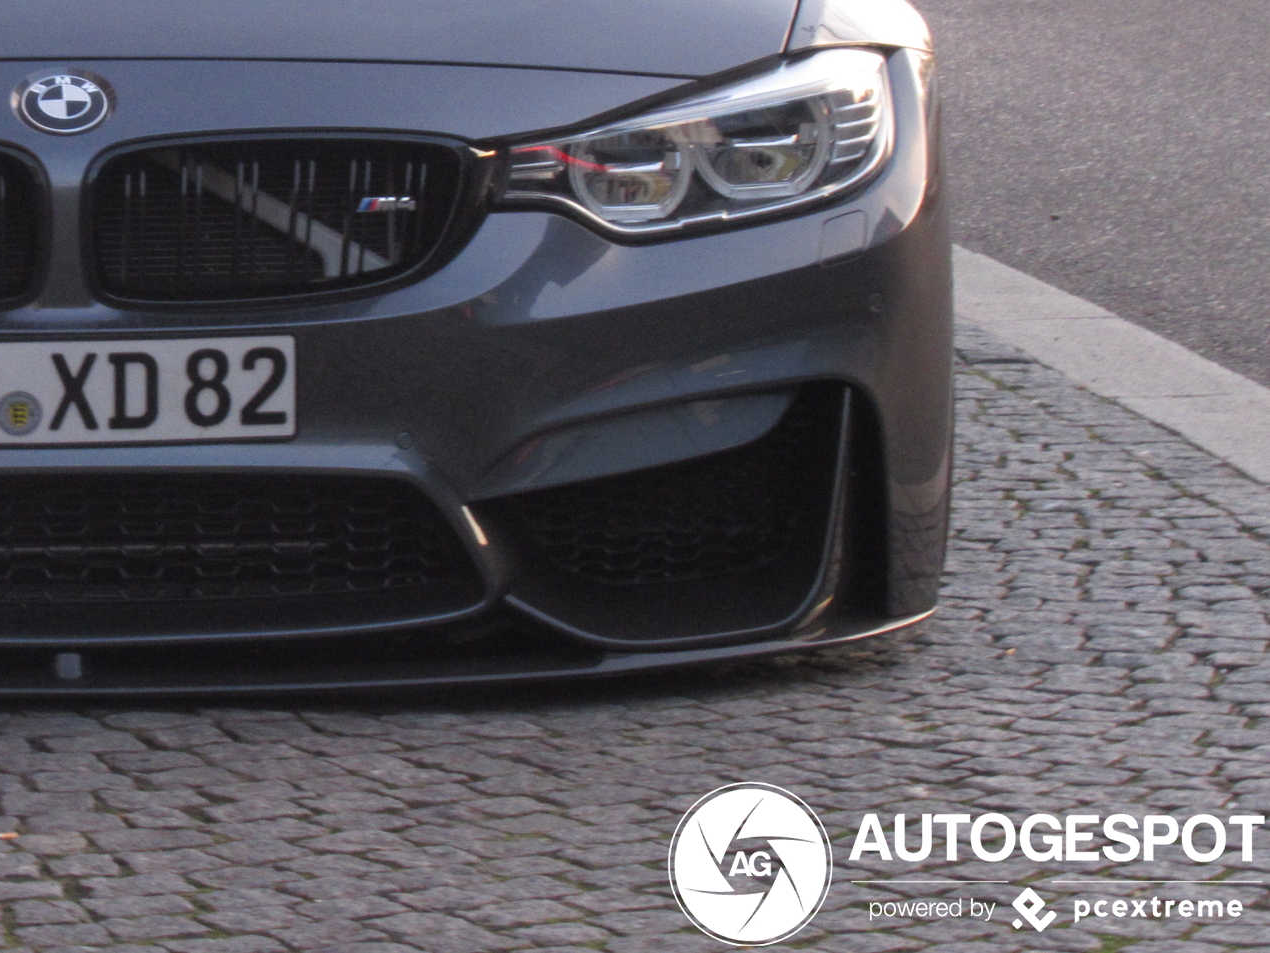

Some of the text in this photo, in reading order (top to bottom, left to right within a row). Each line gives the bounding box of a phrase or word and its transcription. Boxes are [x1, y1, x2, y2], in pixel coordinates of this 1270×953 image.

[29, 76, 100, 94] BMW
[48, 352, 160, 432] XD
[183, 347, 287, 432] 82
